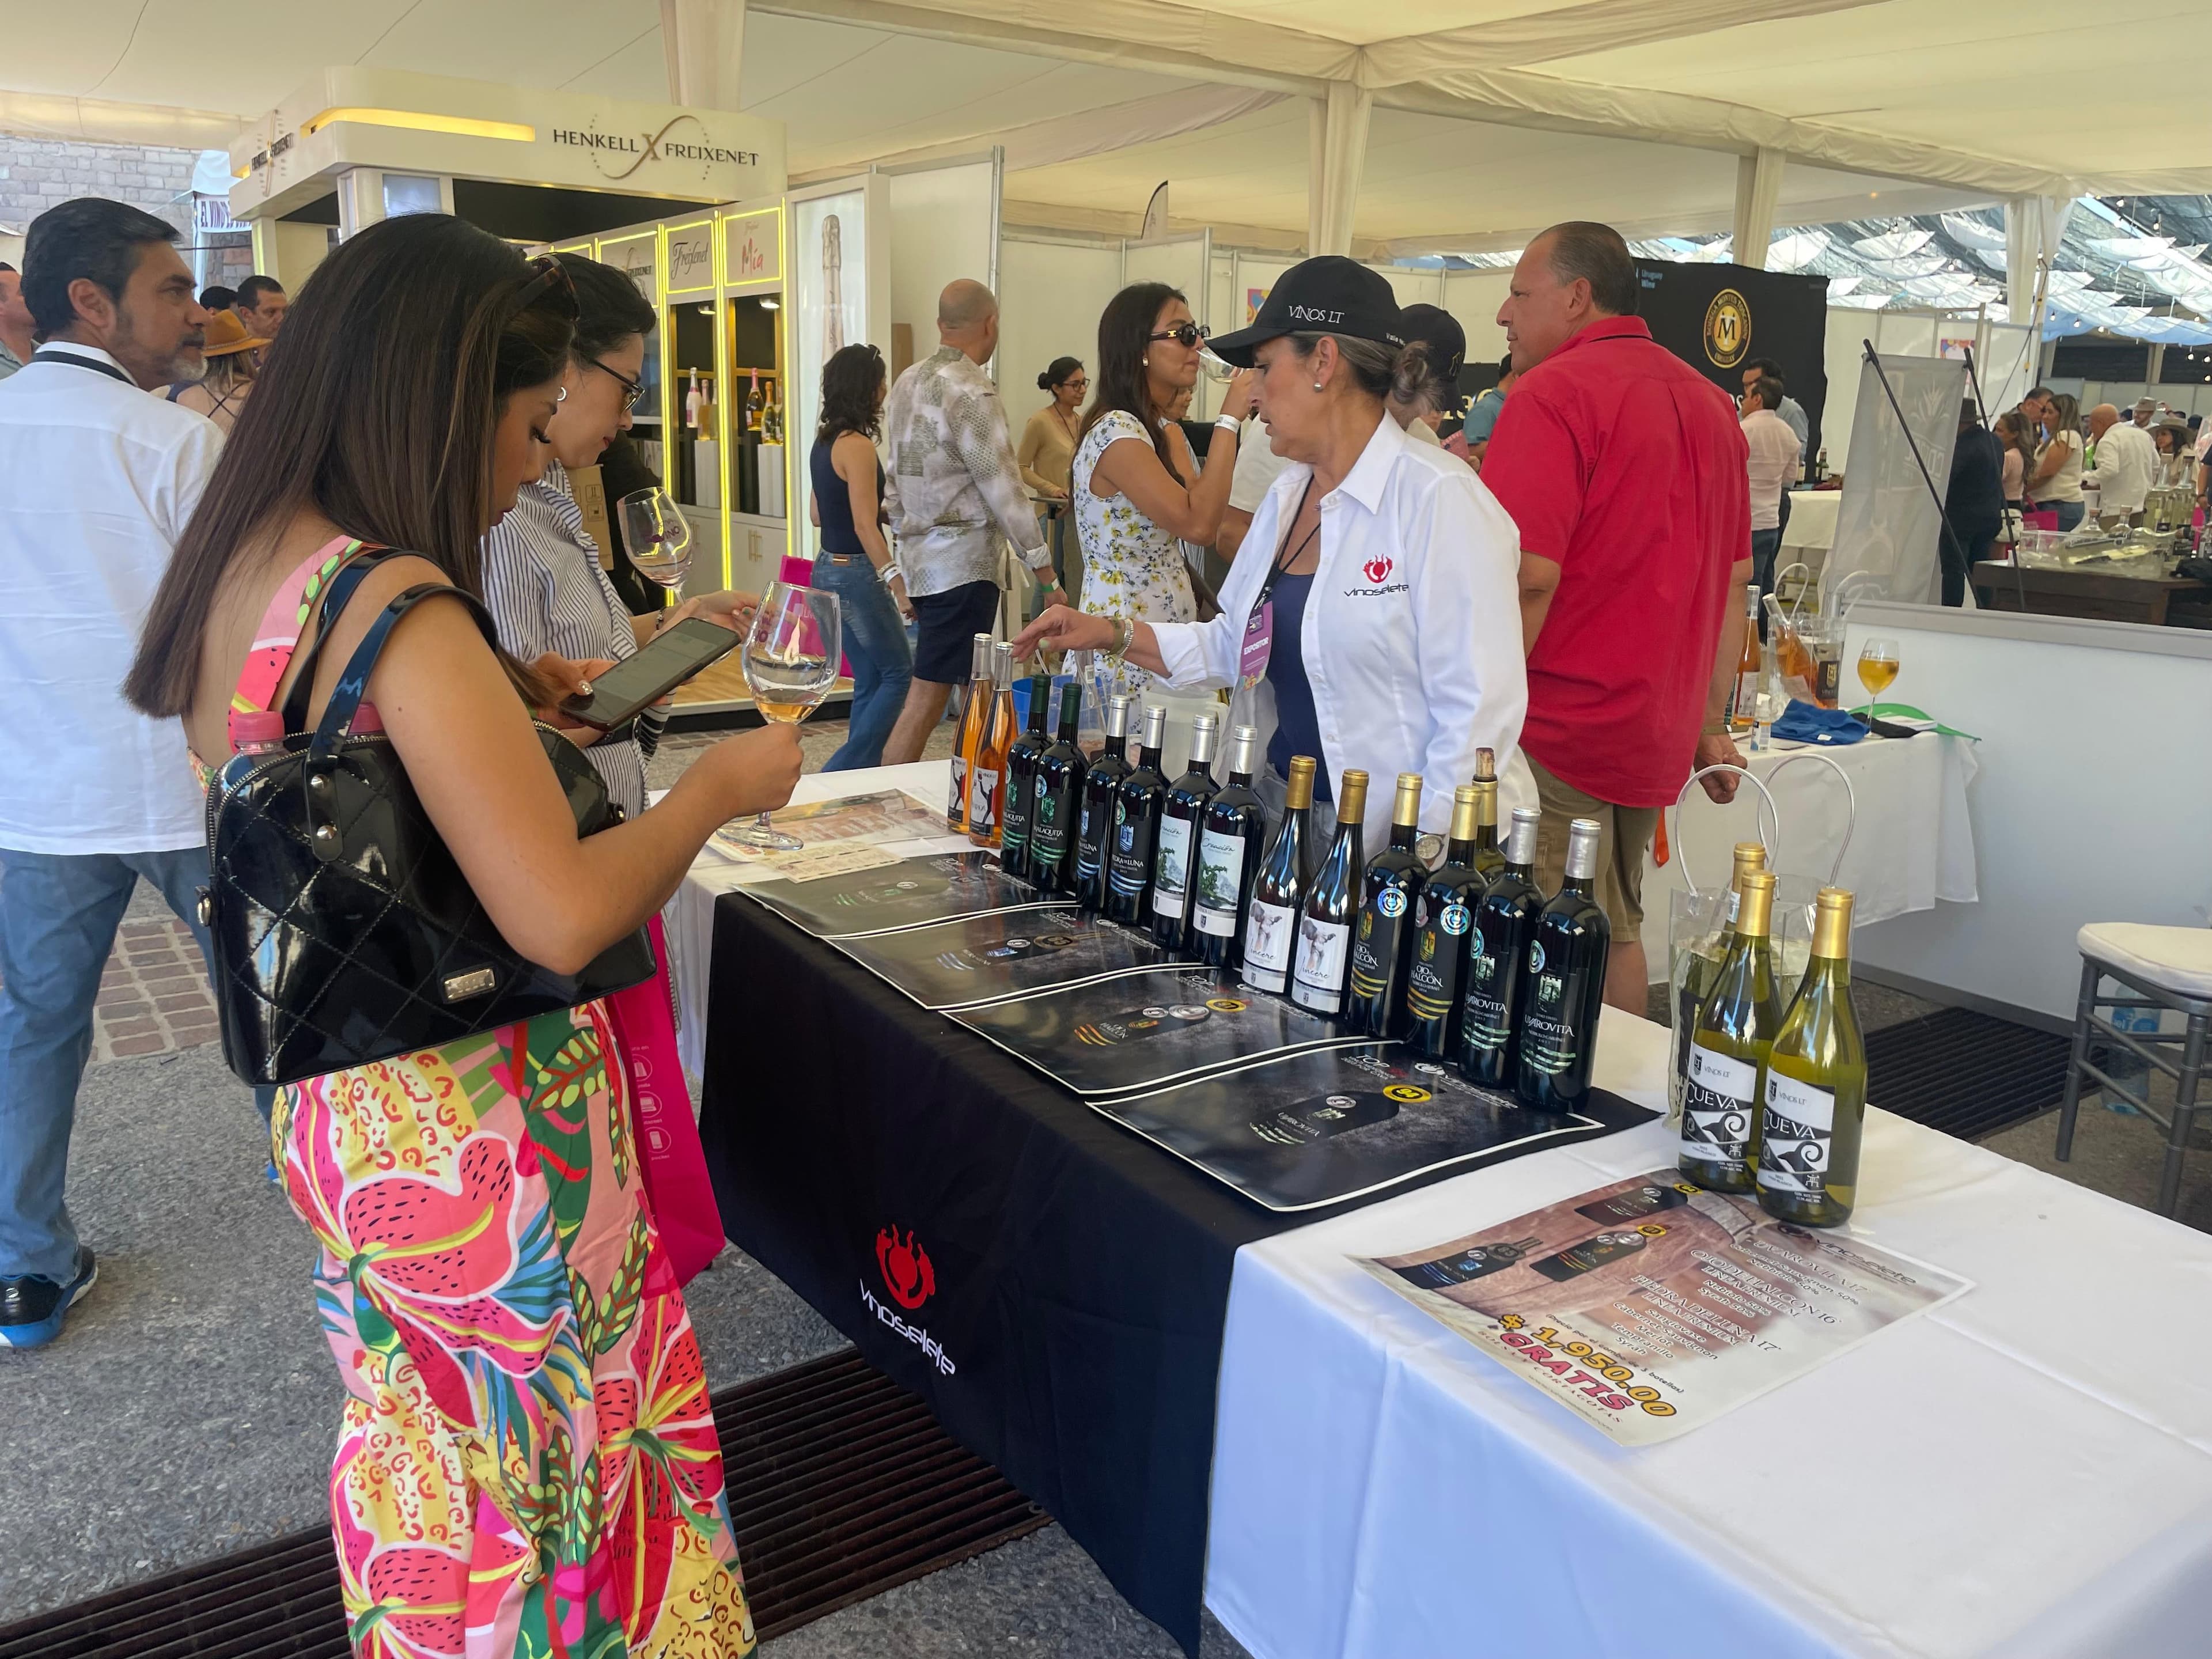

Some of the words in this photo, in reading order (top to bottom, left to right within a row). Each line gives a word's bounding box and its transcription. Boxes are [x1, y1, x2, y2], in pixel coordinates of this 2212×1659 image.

[553, 129, 639, 153] HENKELL
[665, 142, 759, 166] FREIXENET
[1289, 305, 1325, 322] VINOS
[1327, 310, 1345, 324] LT
[1344, 583, 1409, 597] vinoselete
[1244, 637, 1269, 656] EXPOSITOR
[1202, 838, 1236, 853] Creación
[1127, 858, 1143, 868] LUNA
[1465, 992, 1508, 1014] UVAROVITA
[1525, 1014, 1575, 1037] UVAROVITA
[1356, 1054, 1390, 1067] TOP
[1705, 1066, 1721, 1076] VINOS
[1396, 1088, 1420, 1098] 94
[1687, 1082, 1738, 1111] CUEVA
[1778, 1092, 1797, 1104] VINOS
[1798, 1097, 1806, 1105] LT
[1763, 1108, 1816, 1139] CUEVA
[1817, 1239, 1916, 1284] vinoselete
[1797, 1281, 1820, 1296] 50%
[1837, 1291, 1859, 1306] 50%
[1699, 1287, 1730, 1306] Syrah
[1730, 1302, 1756, 1318] 50%
[1747, 1299, 1771, 1316] 50%
[860, 1278, 956, 1376] vinoselete
[1613, 1302, 1661, 1330] Cabernet
[1662, 1327, 1718, 1360] Sauvignon
[1636, 1325, 1673, 1346] Merlot
[1613, 1323, 1673, 1359] Tempranillo
[1616, 1336, 1647, 1355] Syrah
[1498, 1313, 1527, 1330] $
[1531, 1327, 1677, 1416] 1,950.00
[1500, 1332, 1635, 1410] GRATIS
[1647, 1370, 1685, 1395] botellas)
